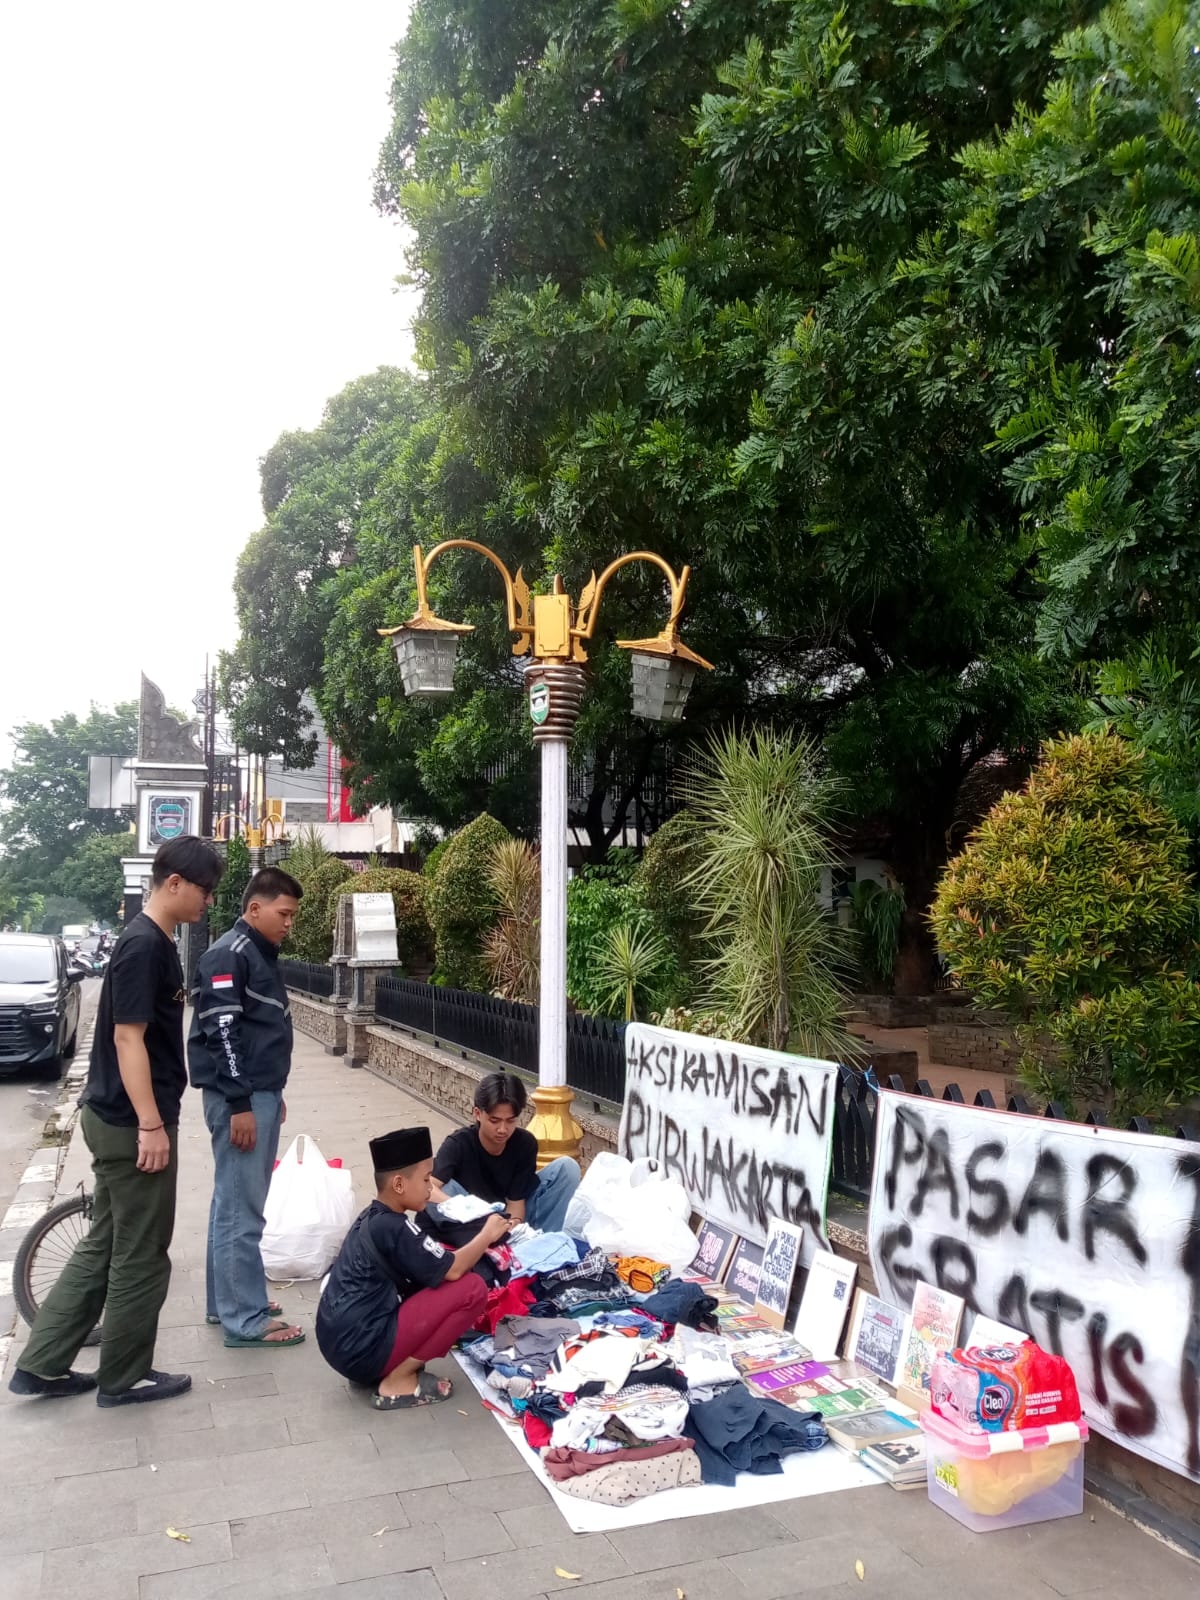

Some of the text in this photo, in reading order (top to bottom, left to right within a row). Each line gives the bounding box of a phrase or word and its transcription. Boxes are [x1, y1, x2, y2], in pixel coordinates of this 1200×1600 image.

[627, 1036, 830, 1136] AKSI KAMISAN
[624, 1089, 829, 1251] PURWAKARTA
[884, 1103, 1149, 1266] PASAR
[879, 1223, 1159, 1436] GRATIS
[984, 1393, 1003, 1410] Cleo
